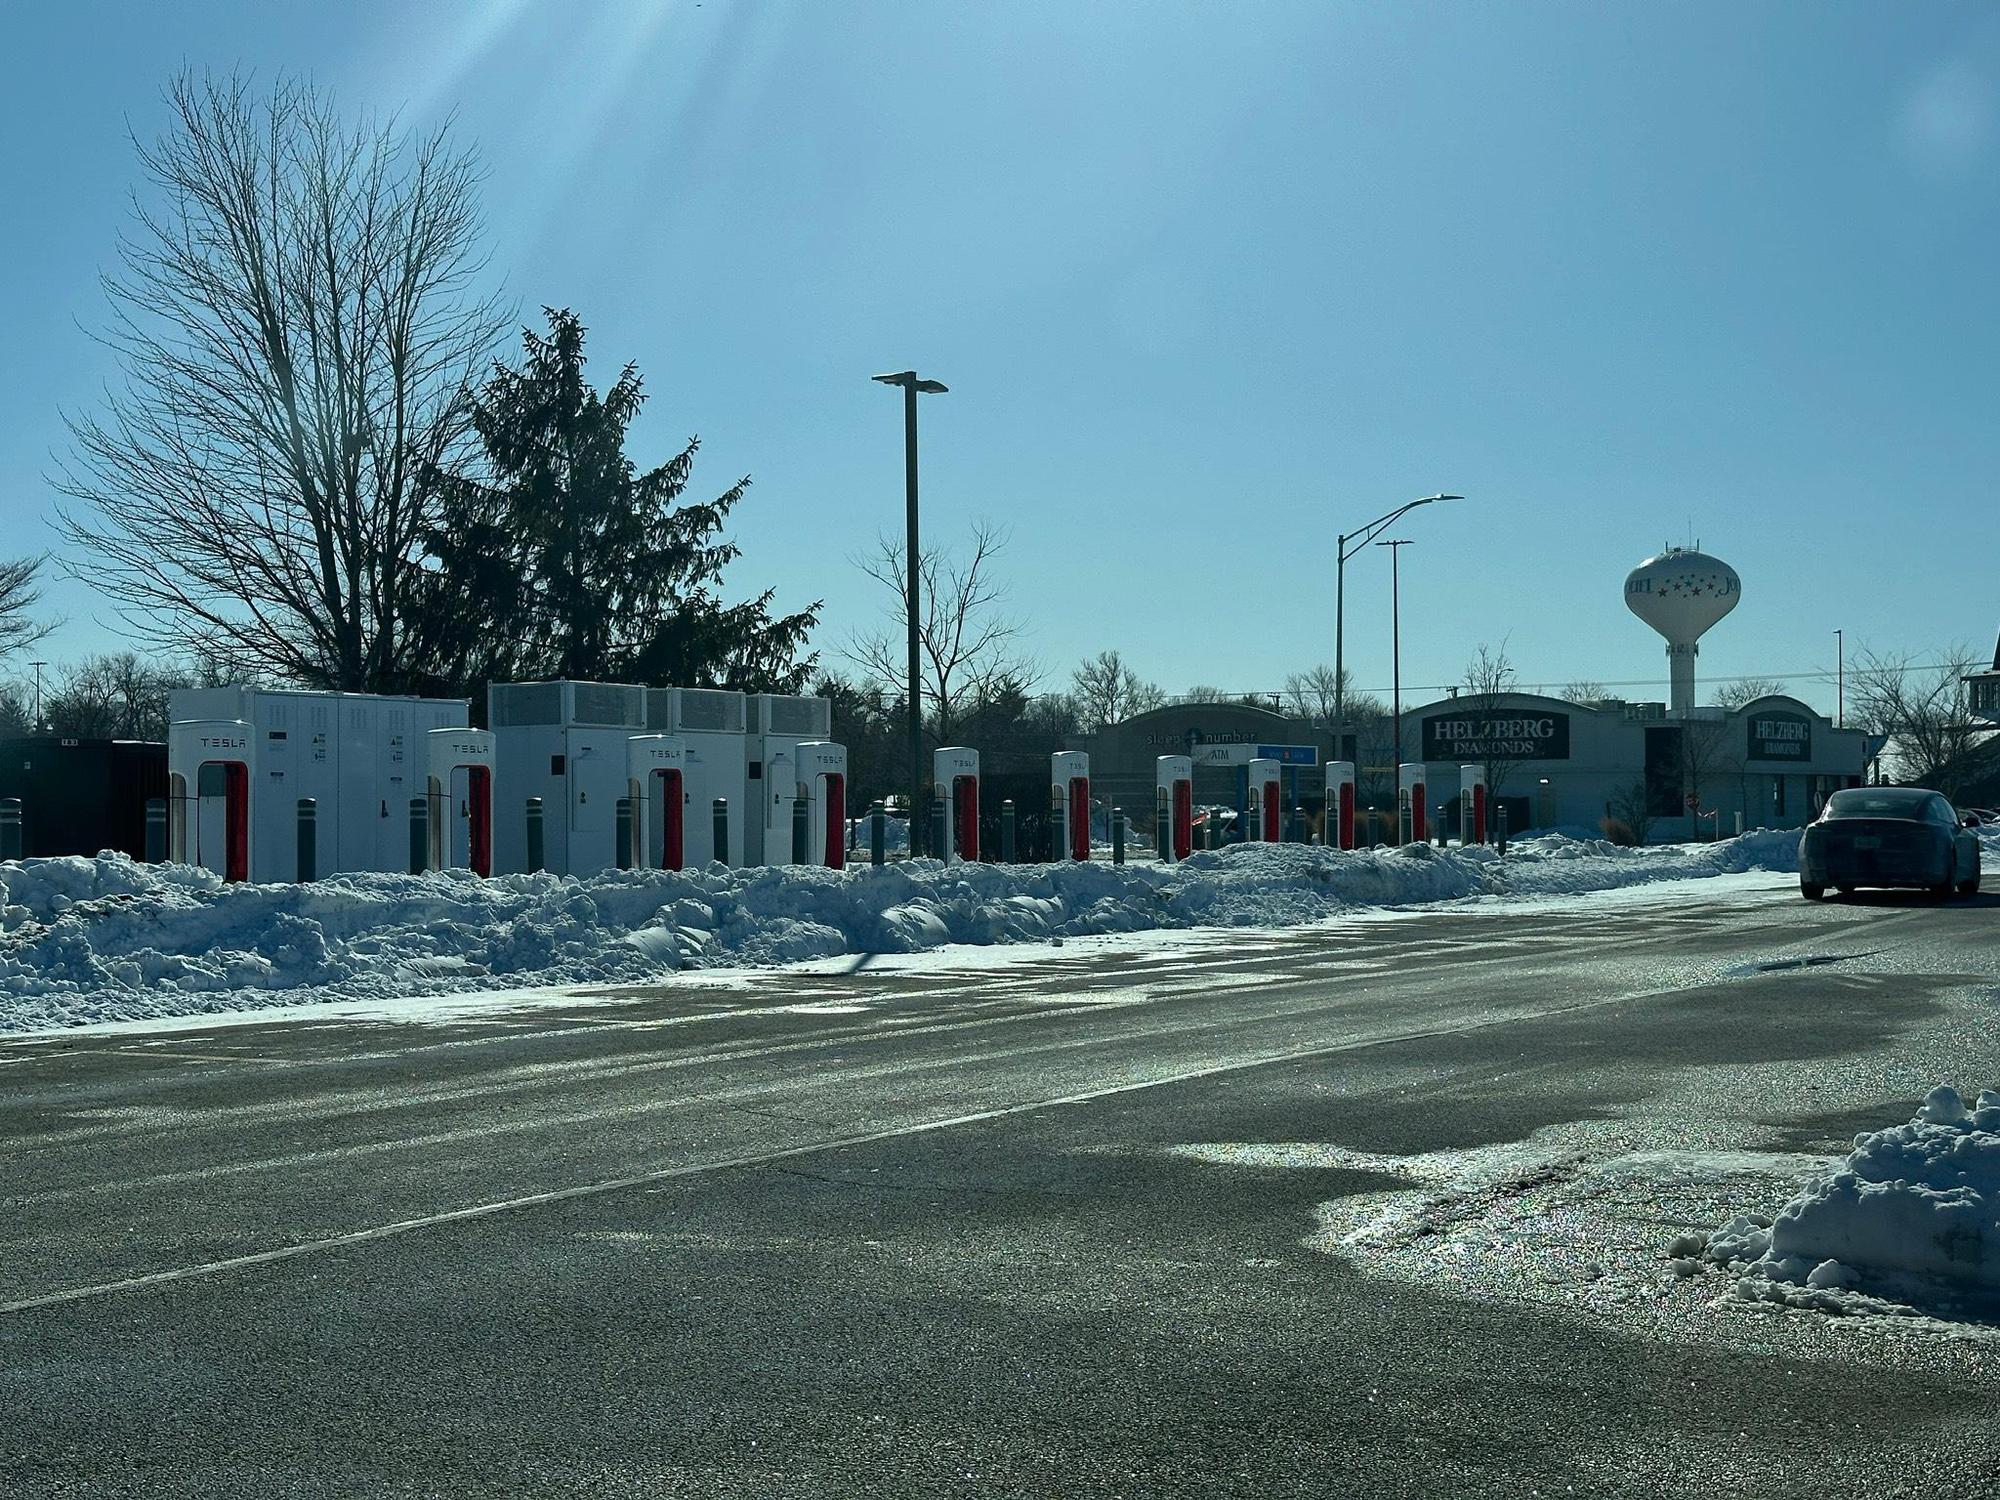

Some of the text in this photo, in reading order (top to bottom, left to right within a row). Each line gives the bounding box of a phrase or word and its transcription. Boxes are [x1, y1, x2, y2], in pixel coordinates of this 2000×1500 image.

[1434, 718, 1554, 740] HELZBERG
[1755, 720, 1808, 740] HELZBERG
[1205, 728, 1255, 744] number
[200, 738, 246, 748] TESLA
[452, 744, 489, 754] TESLA
[650, 750, 681, 759] TESLA
[816, 755, 843, 764] TESLA
[1210, 749, 1230, 760] ATM
[953, 760, 977, 768] TESLA
